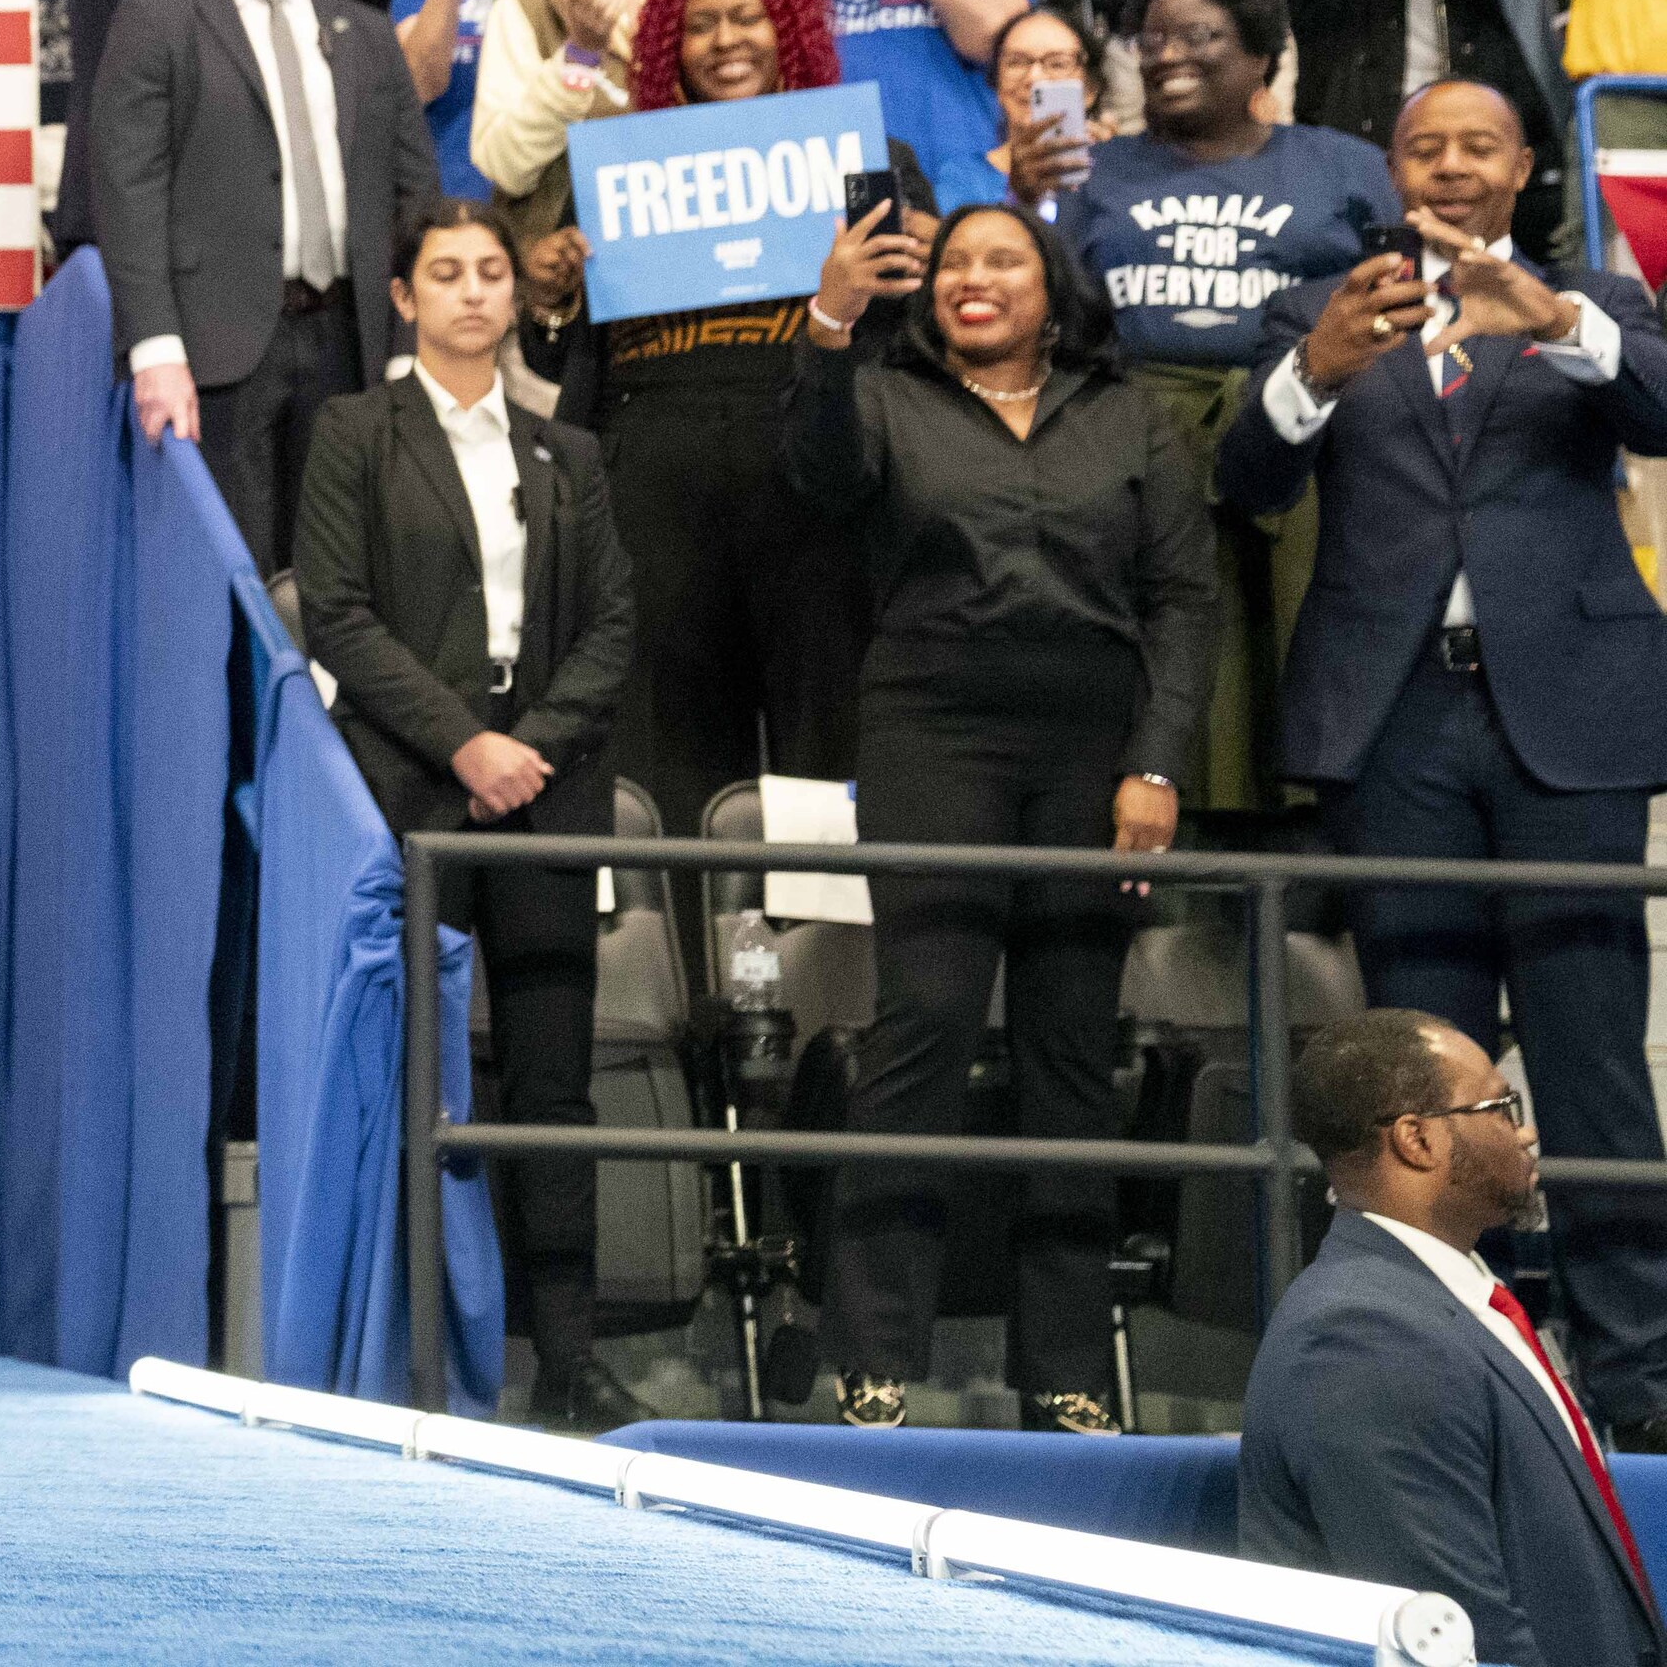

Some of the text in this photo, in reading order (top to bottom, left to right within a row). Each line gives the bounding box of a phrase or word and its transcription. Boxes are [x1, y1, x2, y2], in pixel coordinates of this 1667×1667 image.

[596, 131, 864, 242] FREEDOM
[1129, 193, 1294, 238] KAMALA
[1105, 263, 1302, 310] EVERYBOD
